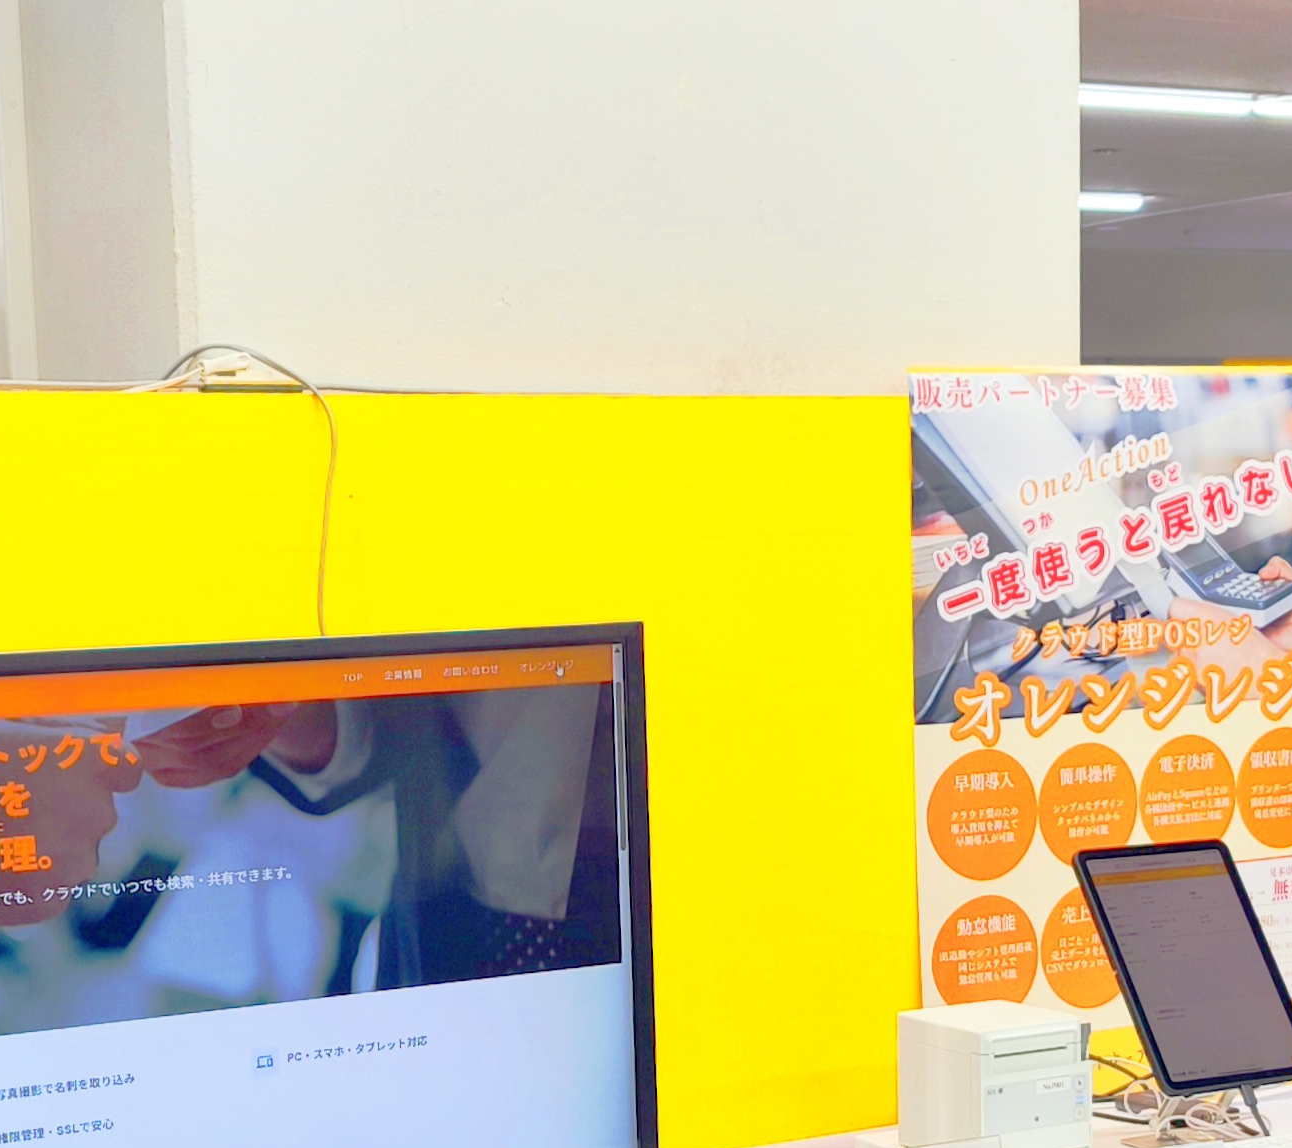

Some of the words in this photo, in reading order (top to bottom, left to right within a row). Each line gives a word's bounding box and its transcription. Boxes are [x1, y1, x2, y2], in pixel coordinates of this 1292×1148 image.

[918, 372, 1176, 418] 販売パートナー募集
[1149, 463, 1180, 490] もど
[1021, 508, 1053, 535] つか
[935, 532, 990, 571] いちど
[342, 672, 363, 684] TOP
[383, 668, 423, 682] 企業情報
[443, 662, 499, 678] お問い合わせ
[1059, 762, 1116, 788] 簡単操作
[1159, 750, 1215, 776] 電子決済
[953, 765, 1014, 796] 早期導入
